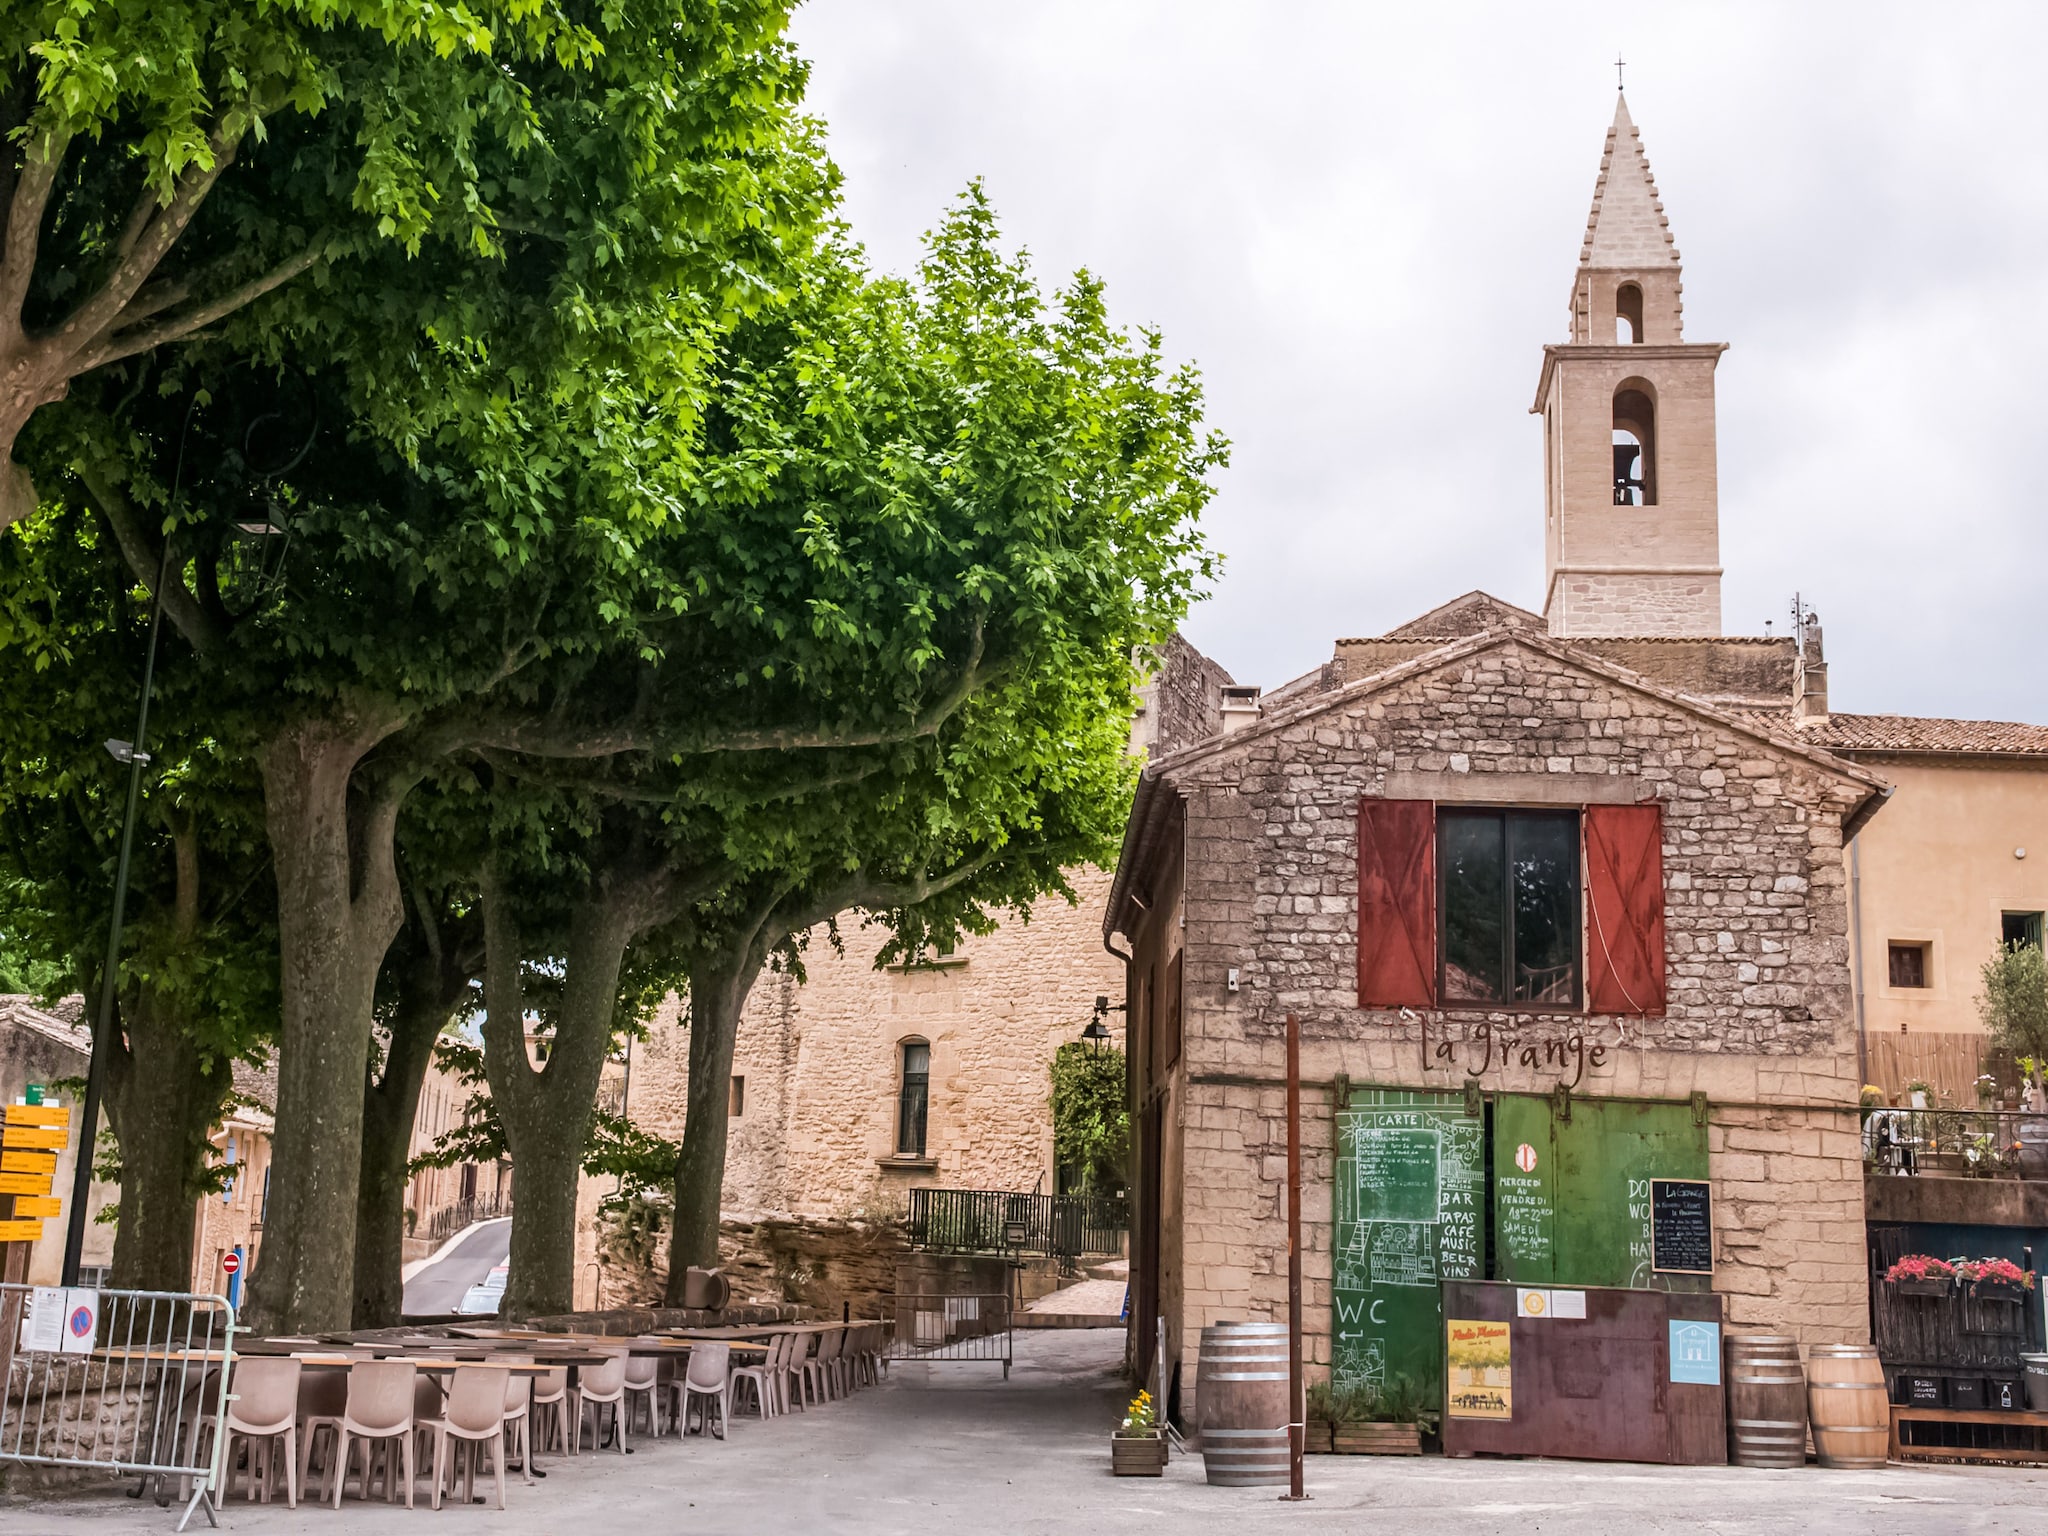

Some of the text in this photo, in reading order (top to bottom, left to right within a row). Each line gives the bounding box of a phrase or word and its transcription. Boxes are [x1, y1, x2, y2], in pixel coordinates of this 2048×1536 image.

[1415, 1013, 1607, 1090] la grange
[1378, 1114, 1418, 1126] CARTE
[1516, 1187, 1528, 1195] AU
[1440, 1192, 1474, 1206] BAR
[1501, 1195, 1547, 1205] VENDREDI
[1439, 1212, 1477, 1224] TAPAS
[1503, 1220, 1540, 1236] SAMEDI
[1439, 1237, 1477, 1252] MUSIC
[1441, 1251, 1477, 1267] BEER
[1336, 1296, 1386, 1324] WC
